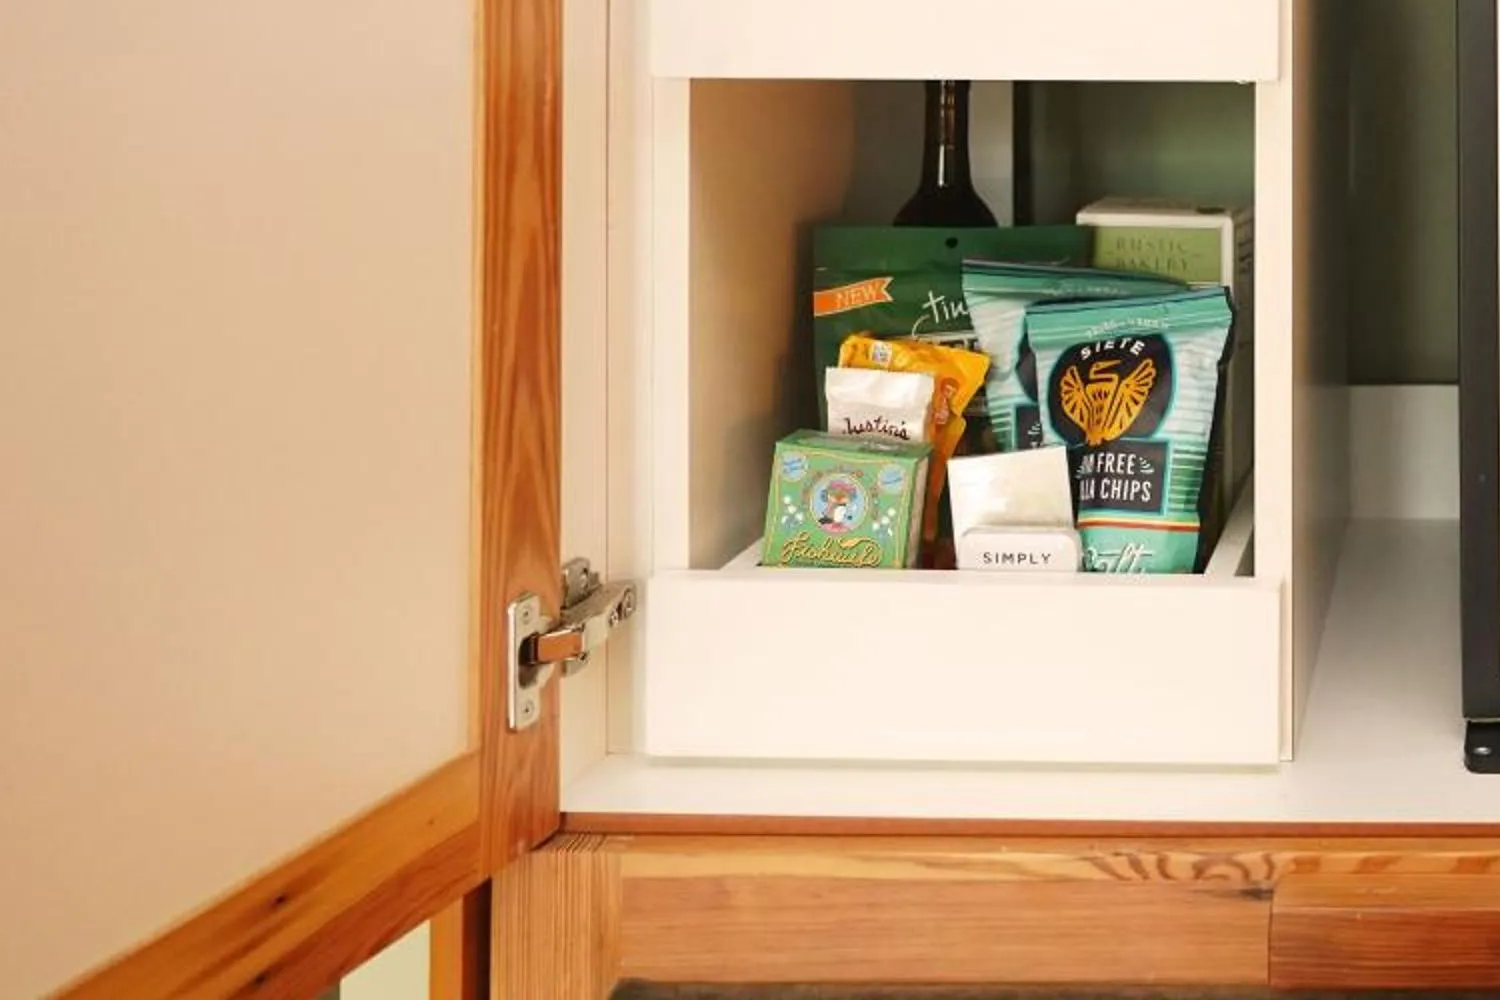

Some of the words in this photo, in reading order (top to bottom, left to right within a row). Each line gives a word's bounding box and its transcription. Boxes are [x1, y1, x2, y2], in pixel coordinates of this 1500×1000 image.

[836, 280, 881, 308] NEW
[1081, 337, 1145, 360] SIETE
[1096, 453, 1137, 475] FREE
[1100, 478, 1152, 502] CHIPS
[983, 551, 1051, 565] SIMPLY
